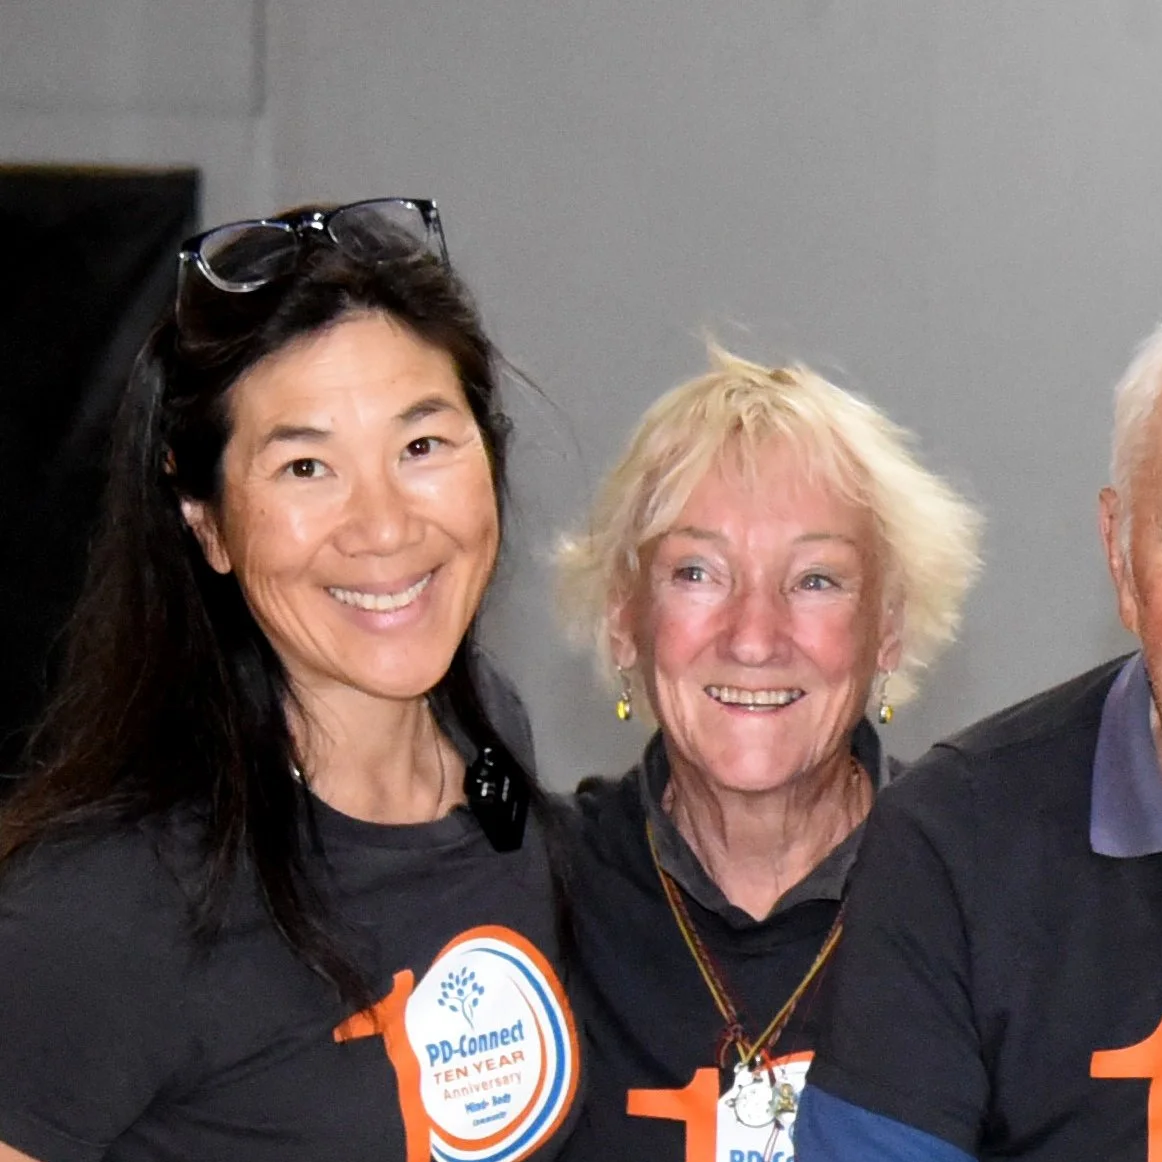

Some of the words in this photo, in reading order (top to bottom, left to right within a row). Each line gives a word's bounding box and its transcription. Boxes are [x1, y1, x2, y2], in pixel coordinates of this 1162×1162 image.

[425, 1019, 525, 1067] PD-Connect
[434, 1066, 469, 1085] TEN
[473, 1050, 525, 1074] YEAR
[443, 1072, 521, 1100] Anniversary
